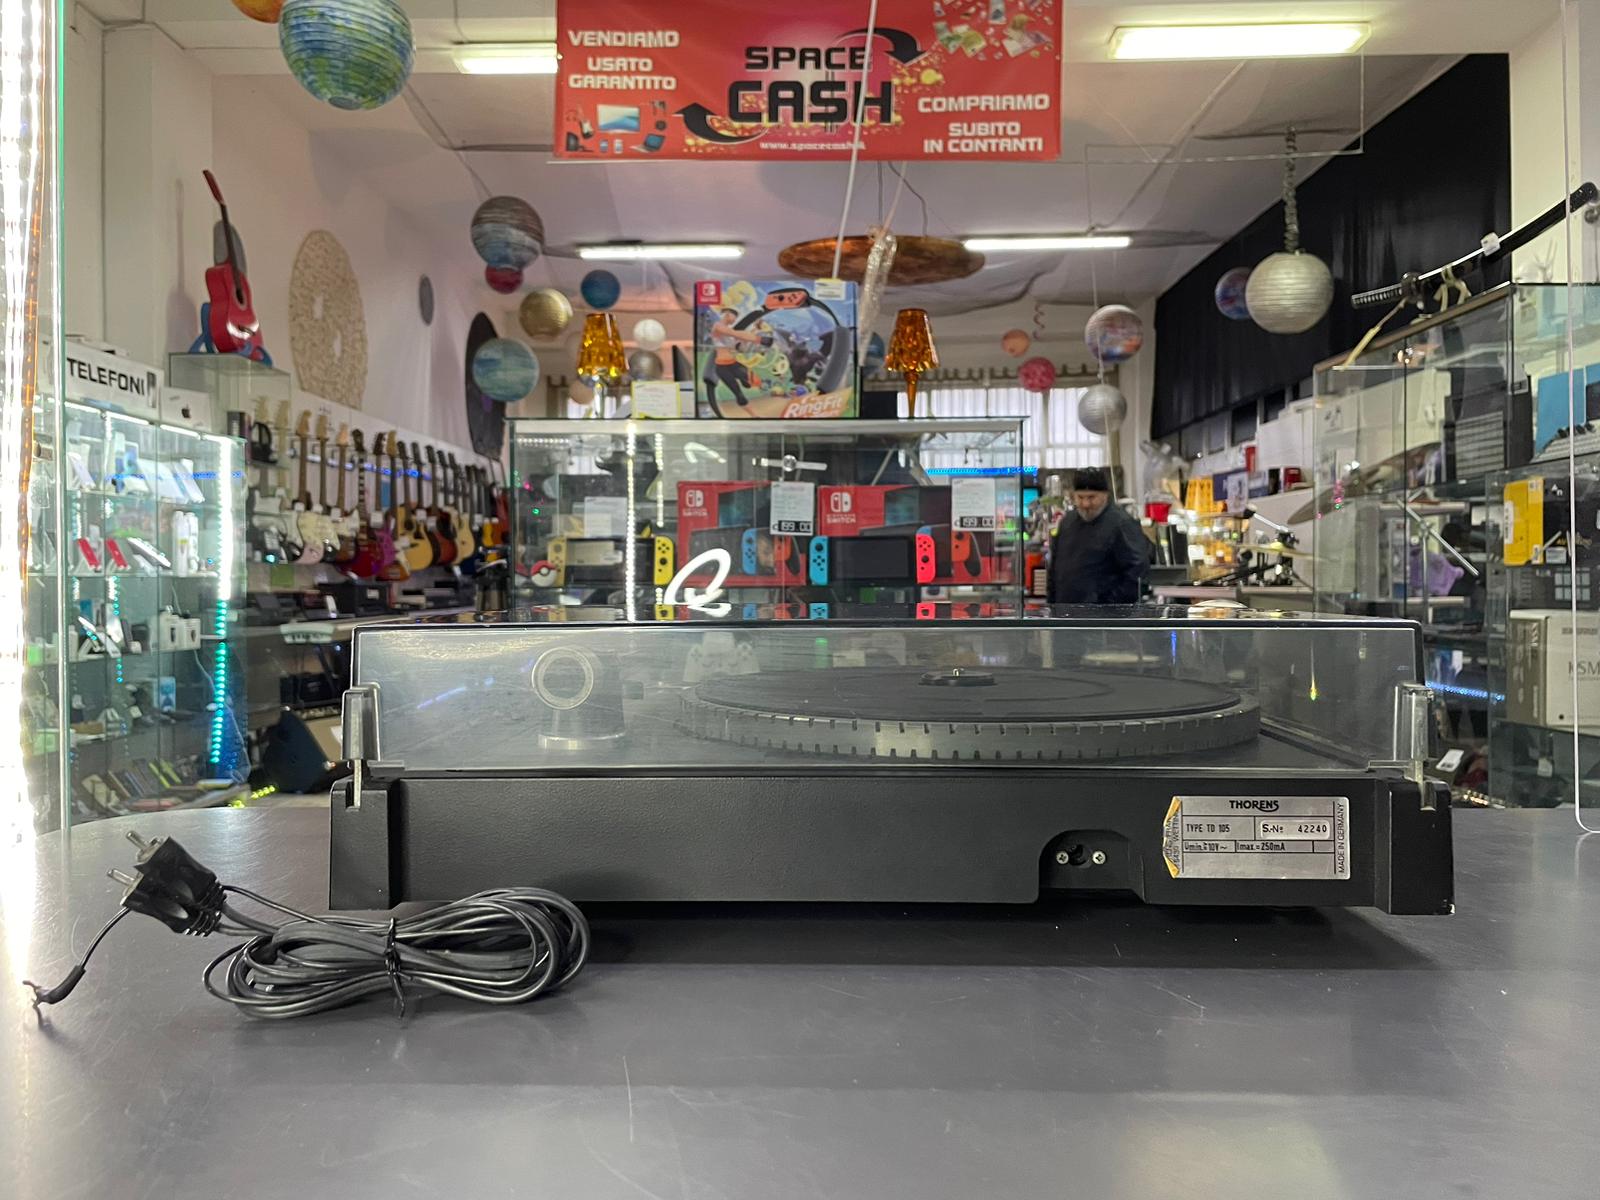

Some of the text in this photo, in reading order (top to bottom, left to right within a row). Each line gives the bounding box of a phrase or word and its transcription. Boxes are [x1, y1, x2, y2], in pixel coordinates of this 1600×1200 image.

[567, 30, 680, 48] VENDIAMO
[587, 57, 653, 72] USATO
[745, 46, 872, 70] SPACE
[568, 74, 677, 90] GARANTITO
[729, 80, 892, 123] CASH
[917, 93, 1050, 113] COMPRIAMO
[948, 121, 1021, 137] SUBITO
[923, 137, 1043, 153] IN CONTANTI
[66, 357, 145, 396] TELEFONI
[1228, 800, 1280, 813] THORENS
[1186, 823, 1231, 833] TYPE TD 105
[1297, 824, 1328, 834] 42240
[1337, 803, 1345, 873] MADE IN GERMANY
